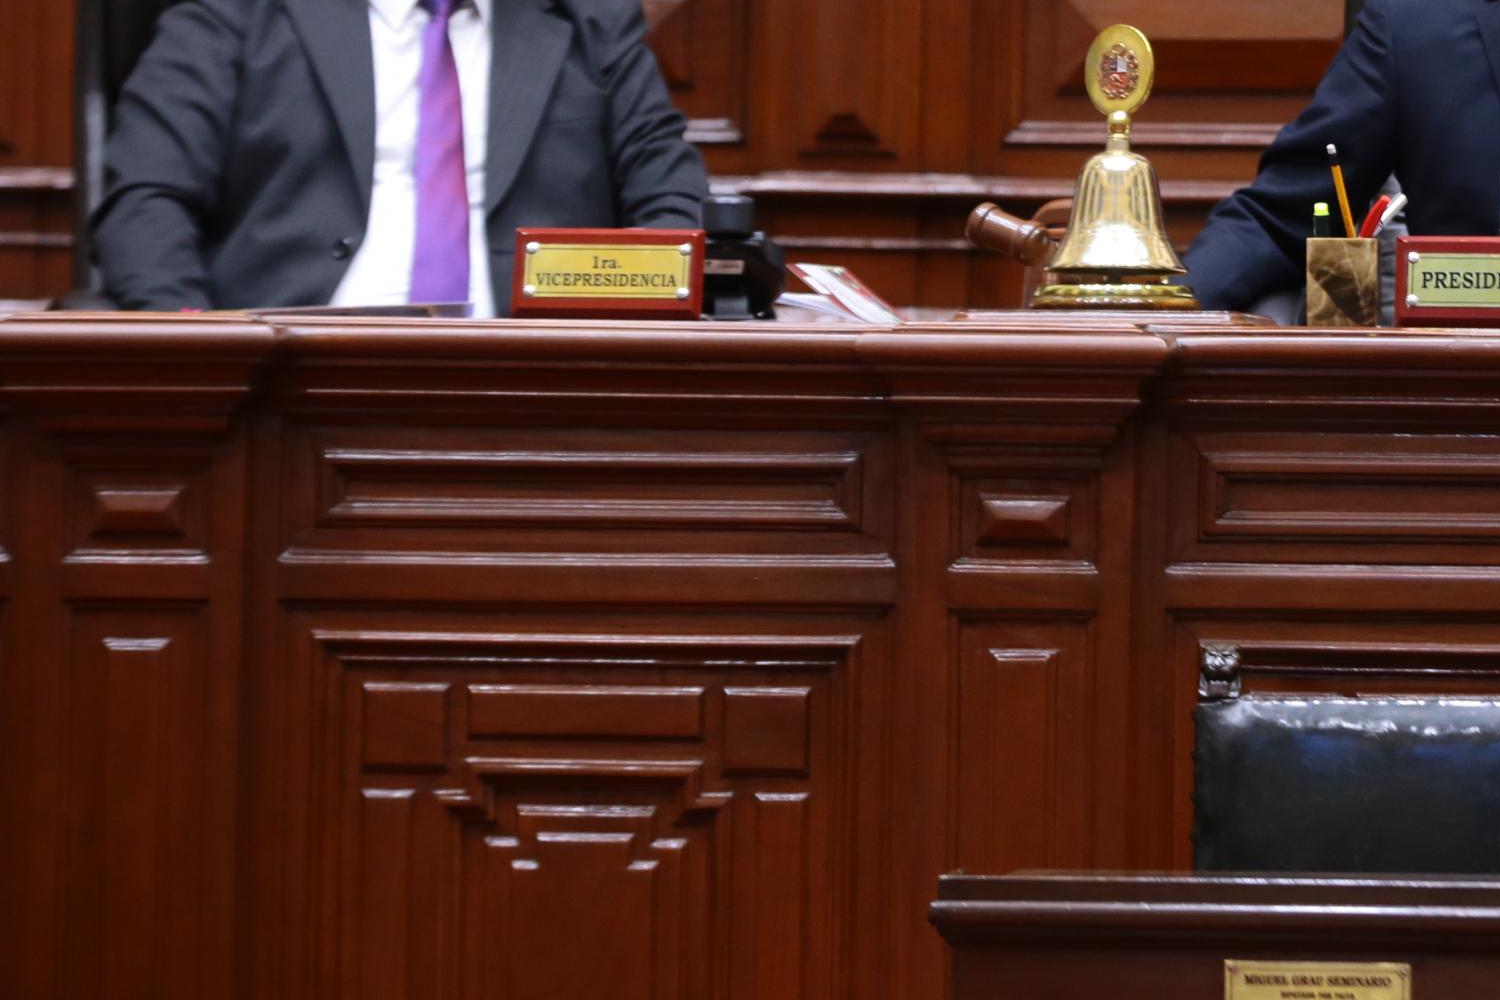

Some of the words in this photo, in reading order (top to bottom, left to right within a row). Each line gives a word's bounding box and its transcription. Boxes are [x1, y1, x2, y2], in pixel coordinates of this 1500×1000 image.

[592, 256, 622, 269] 1ra.
[536, 273, 677, 287] VICEPRESIDENCIA
[1244, 974, 1288, 985] MIGUEL
[1291, 974, 1323, 986] GRAU
[1327, 975, 1392, 988] SEMINARIO
